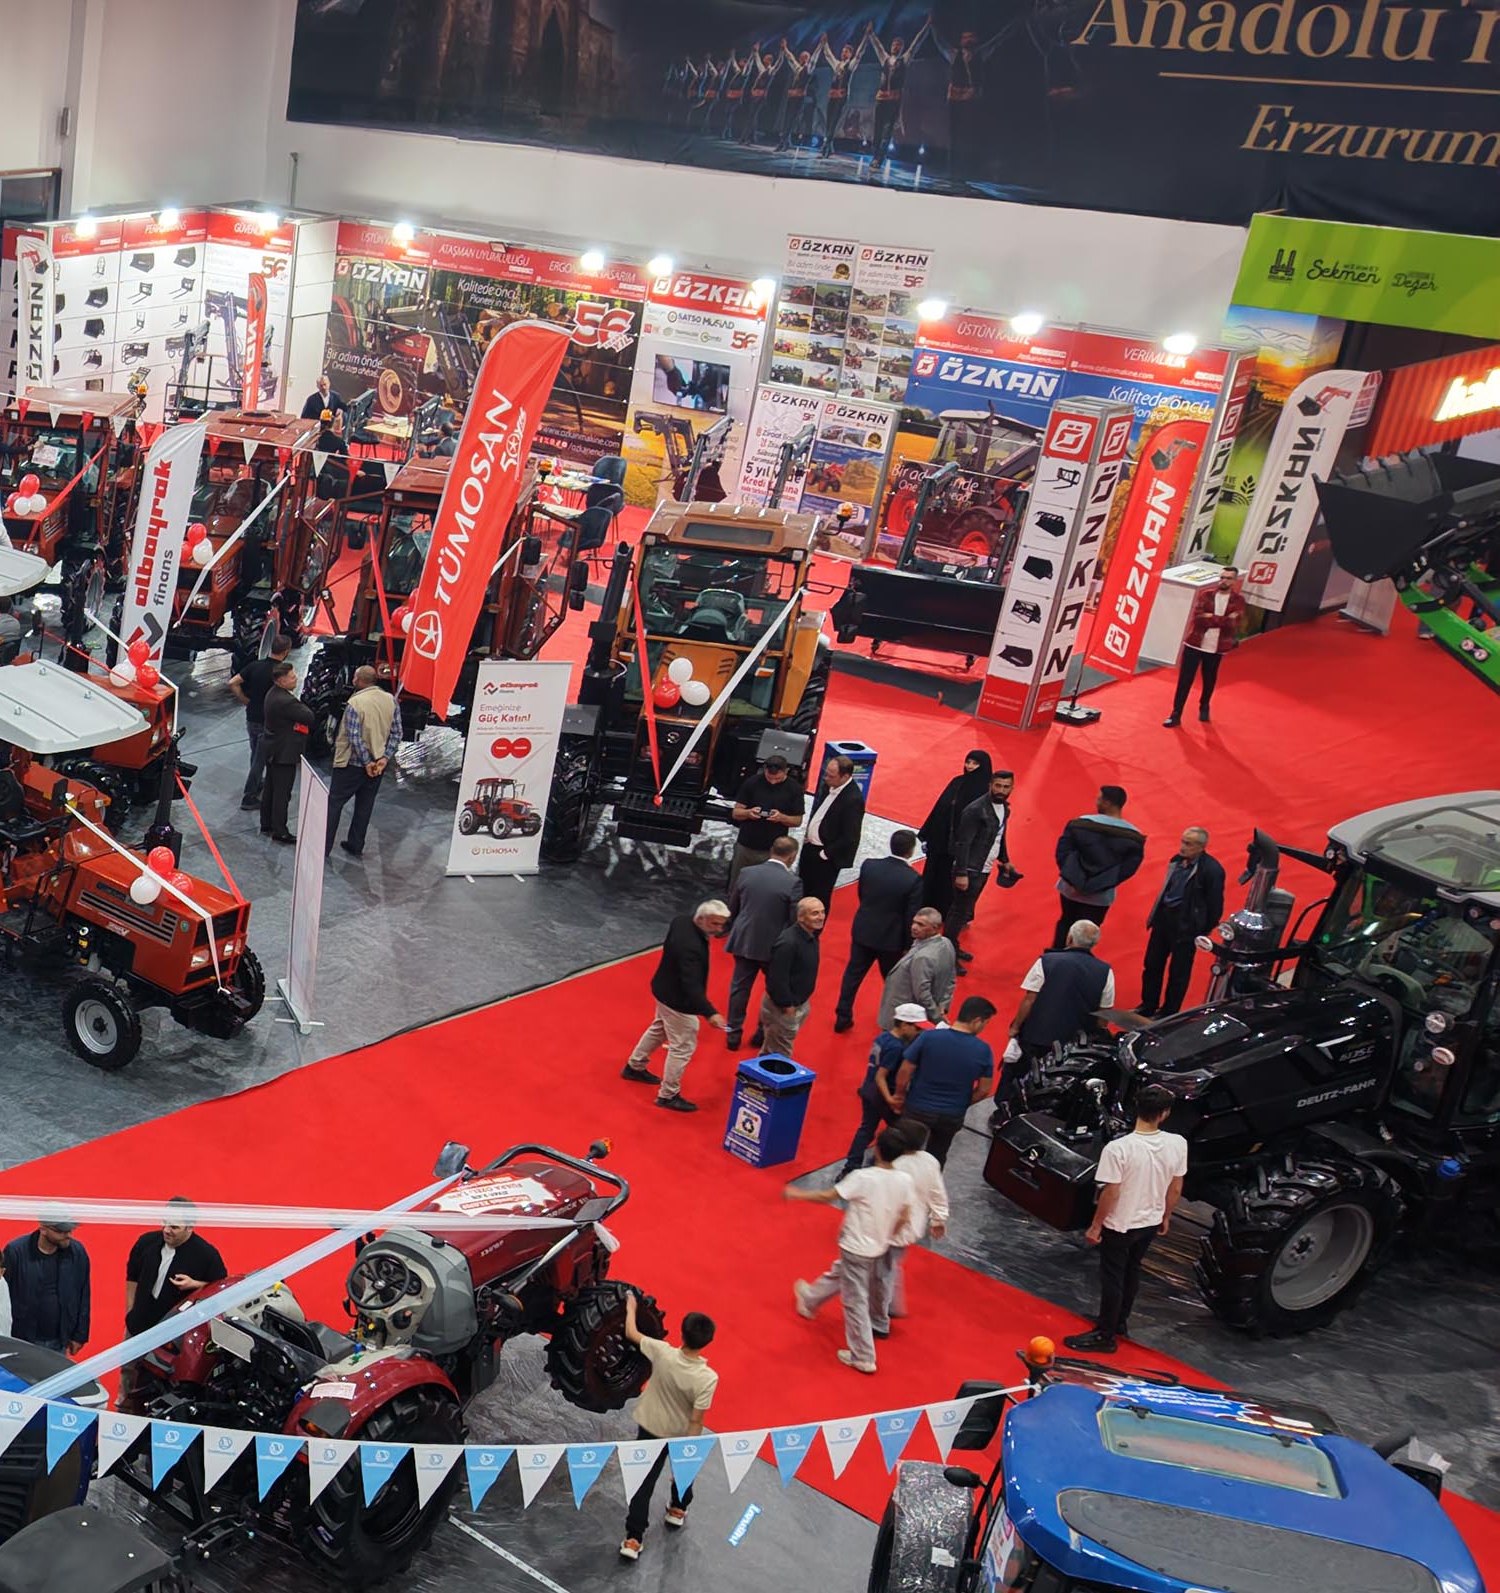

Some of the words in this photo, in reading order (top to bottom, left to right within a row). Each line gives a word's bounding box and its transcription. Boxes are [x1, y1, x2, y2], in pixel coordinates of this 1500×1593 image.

[1240, 103, 1500, 168] Erzurum
[801, 239, 854, 256] ÖZKAN
[874, 249, 928, 266] ÖZKAN
[352, 261, 427, 290] ÖZKAN
[1306, 259, 1381, 285] Sekmen
[673, 276, 762, 311] ÖZKAN
[26, 282, 44, 381] ÖZKAN
[939, 357, 1059, 399] ÖZKAN
[771, 391, 819, 410] ÖZKAN
[1108, 385, 1167, 407] Kalitede
[837, 406, 890, 425] ÖZKAN
[745, 461, 754, 473] 5
[891, 463, 908, 477] Bir
[434, 389, 514, 605] TÜMOSAN
[135, 459, 172, 607] albayrak
[1116, 480, 1176, 625] ÖZKAN
[153, 548, 174, 606] finans
[478, 714, 498, 724] Güç
[501, 714, 531, 723] Katın!
[480, 704, 521, 713] Emeğinize
[1296, 1078, 1377, 1108] DEUTZ-FAHR
